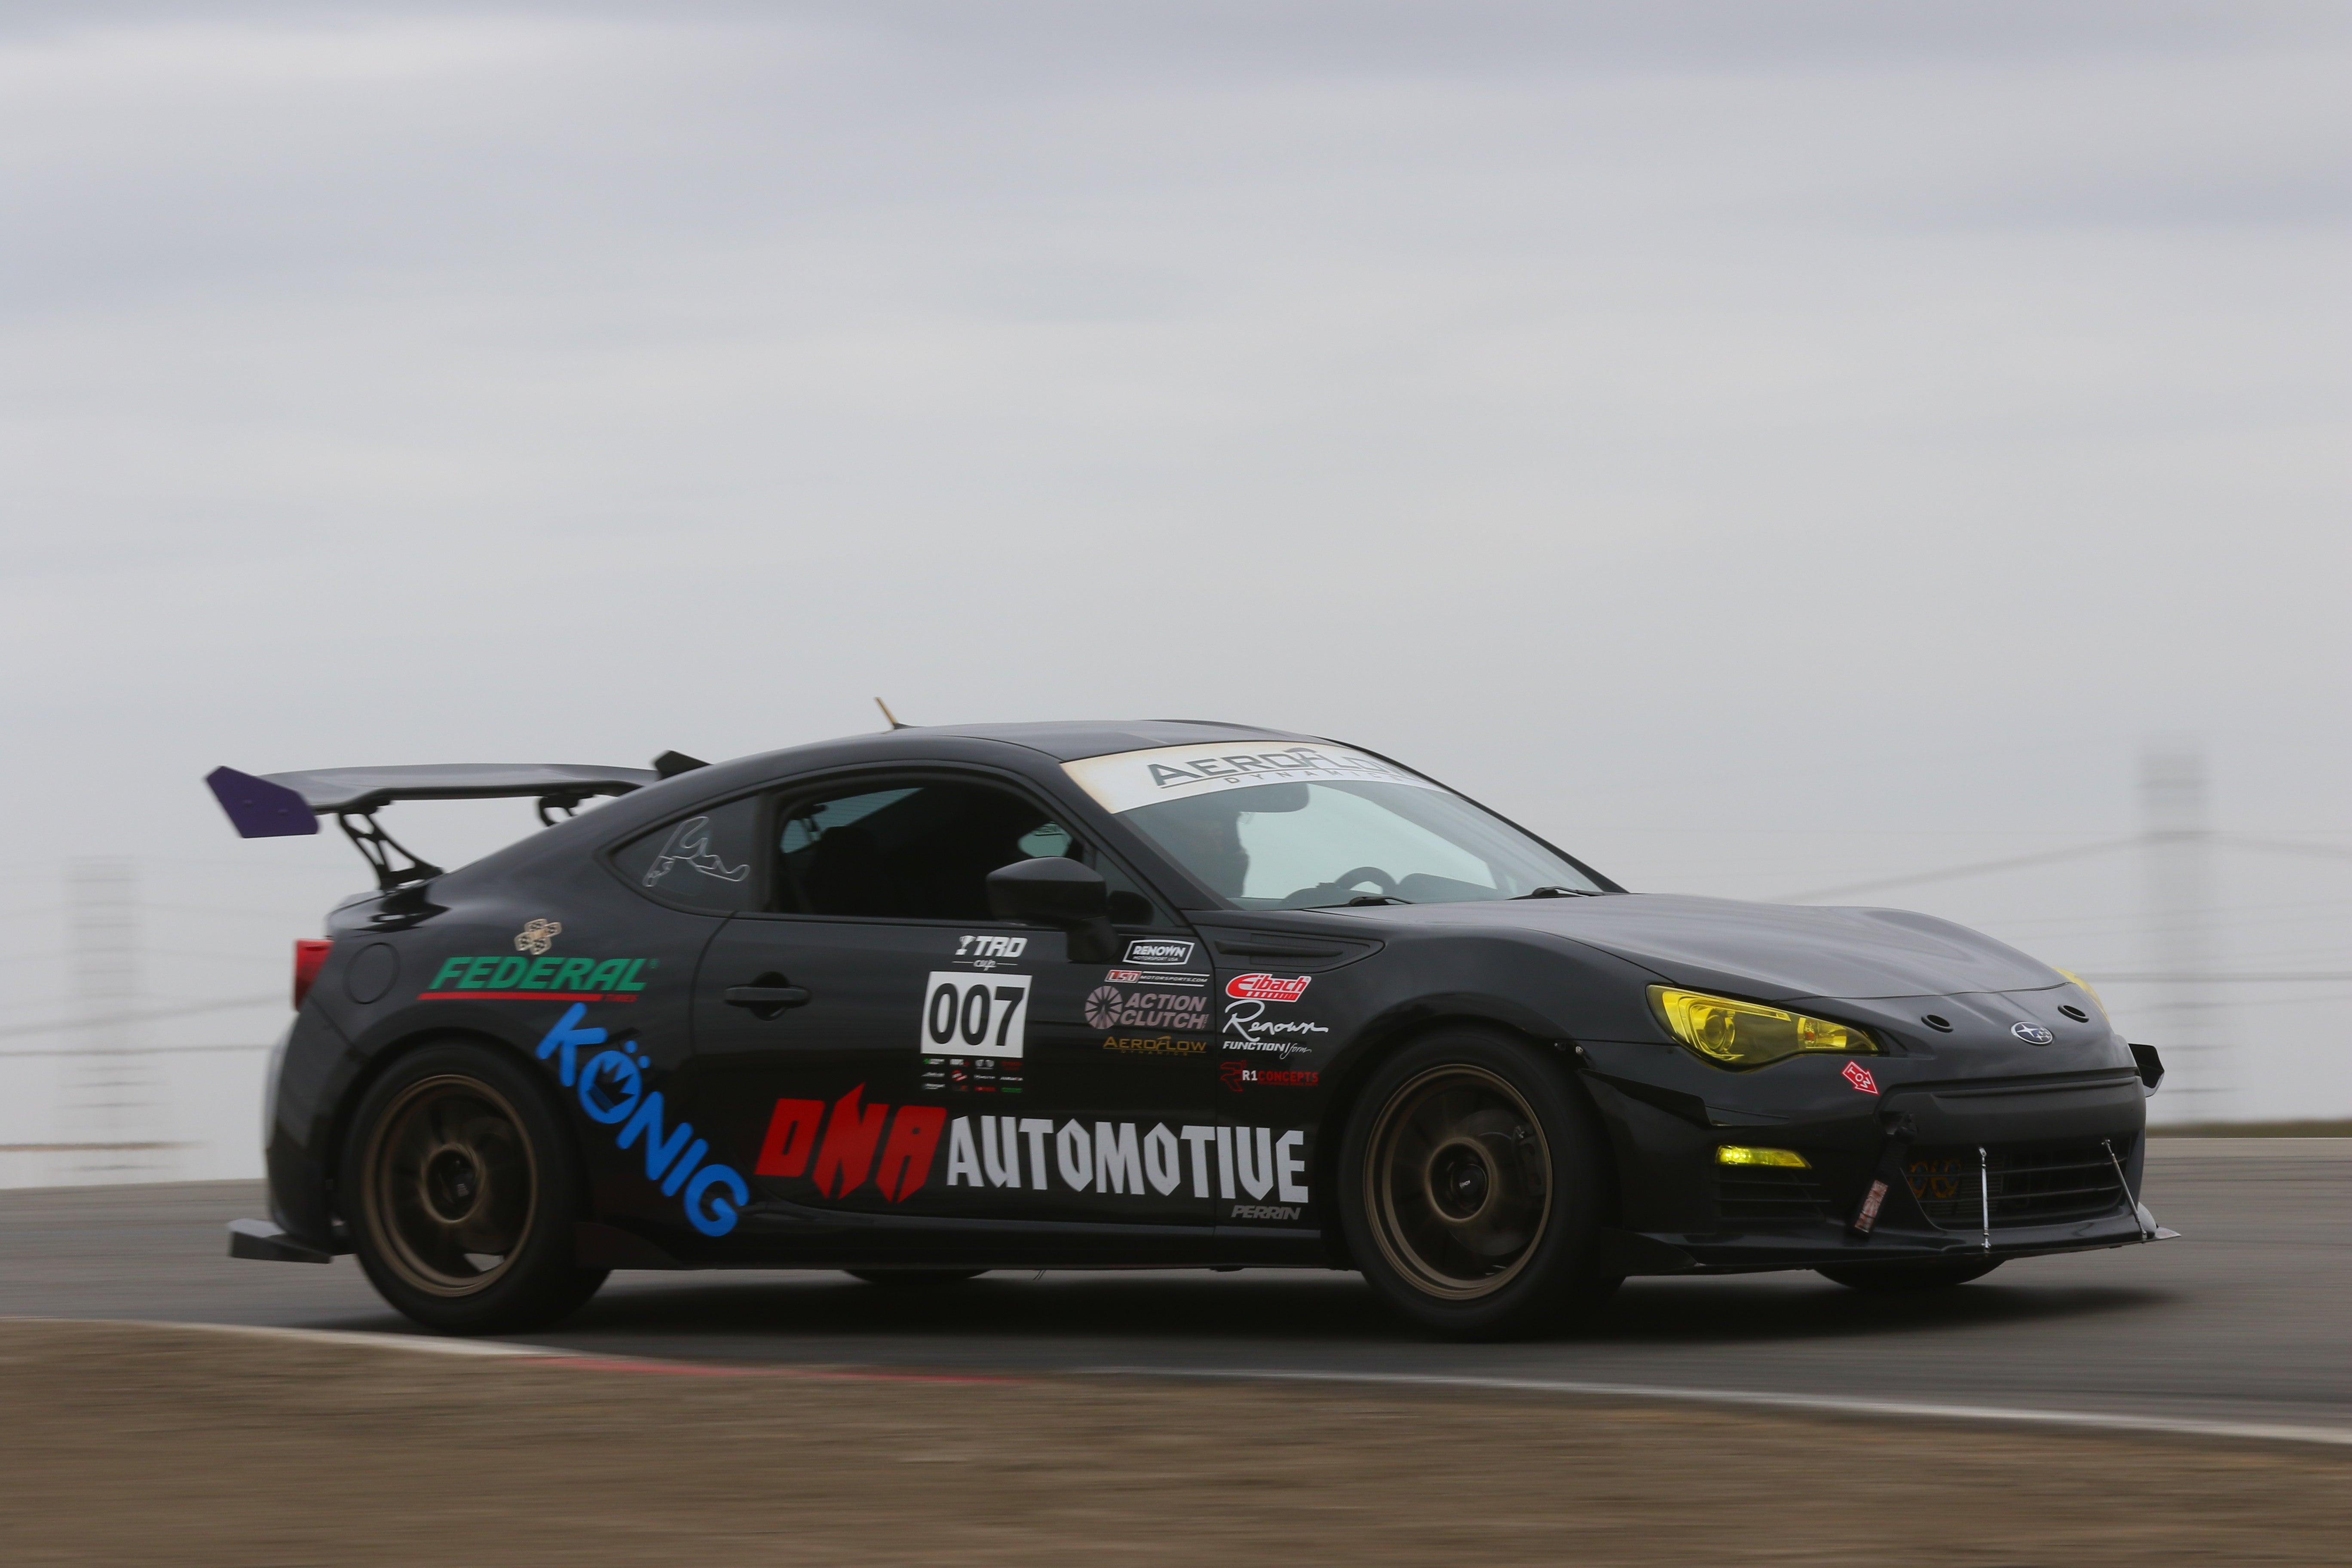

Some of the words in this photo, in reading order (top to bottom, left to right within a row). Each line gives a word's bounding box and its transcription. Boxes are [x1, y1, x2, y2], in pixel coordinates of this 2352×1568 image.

[973, 935, 1028, 958] TRD
[1132, 945, 1186, 958] RENOWN
[428, 956, 649, 991] FEDERAL
[1107, 972, 1139, 982] LSD
[1227, 974, 1308, 996] Eibach
[1124, 992, 1207, 1012] ACTION
[930, 983, 1026, 1046] 007
[1120, 1010, 1205, 1029] CLUTCH
[1222, 999, 1329, 1042] Renown
[1102, 1035, 1207, 1051] AEROFLOW
[1847, 1066, 1871, 1089] TOW
[536, 1002, 750, 1237] KÖNIG
[753, 1081, 947, 1204] DNA
[1231, 1204, 1302, 1220] PERRIN
